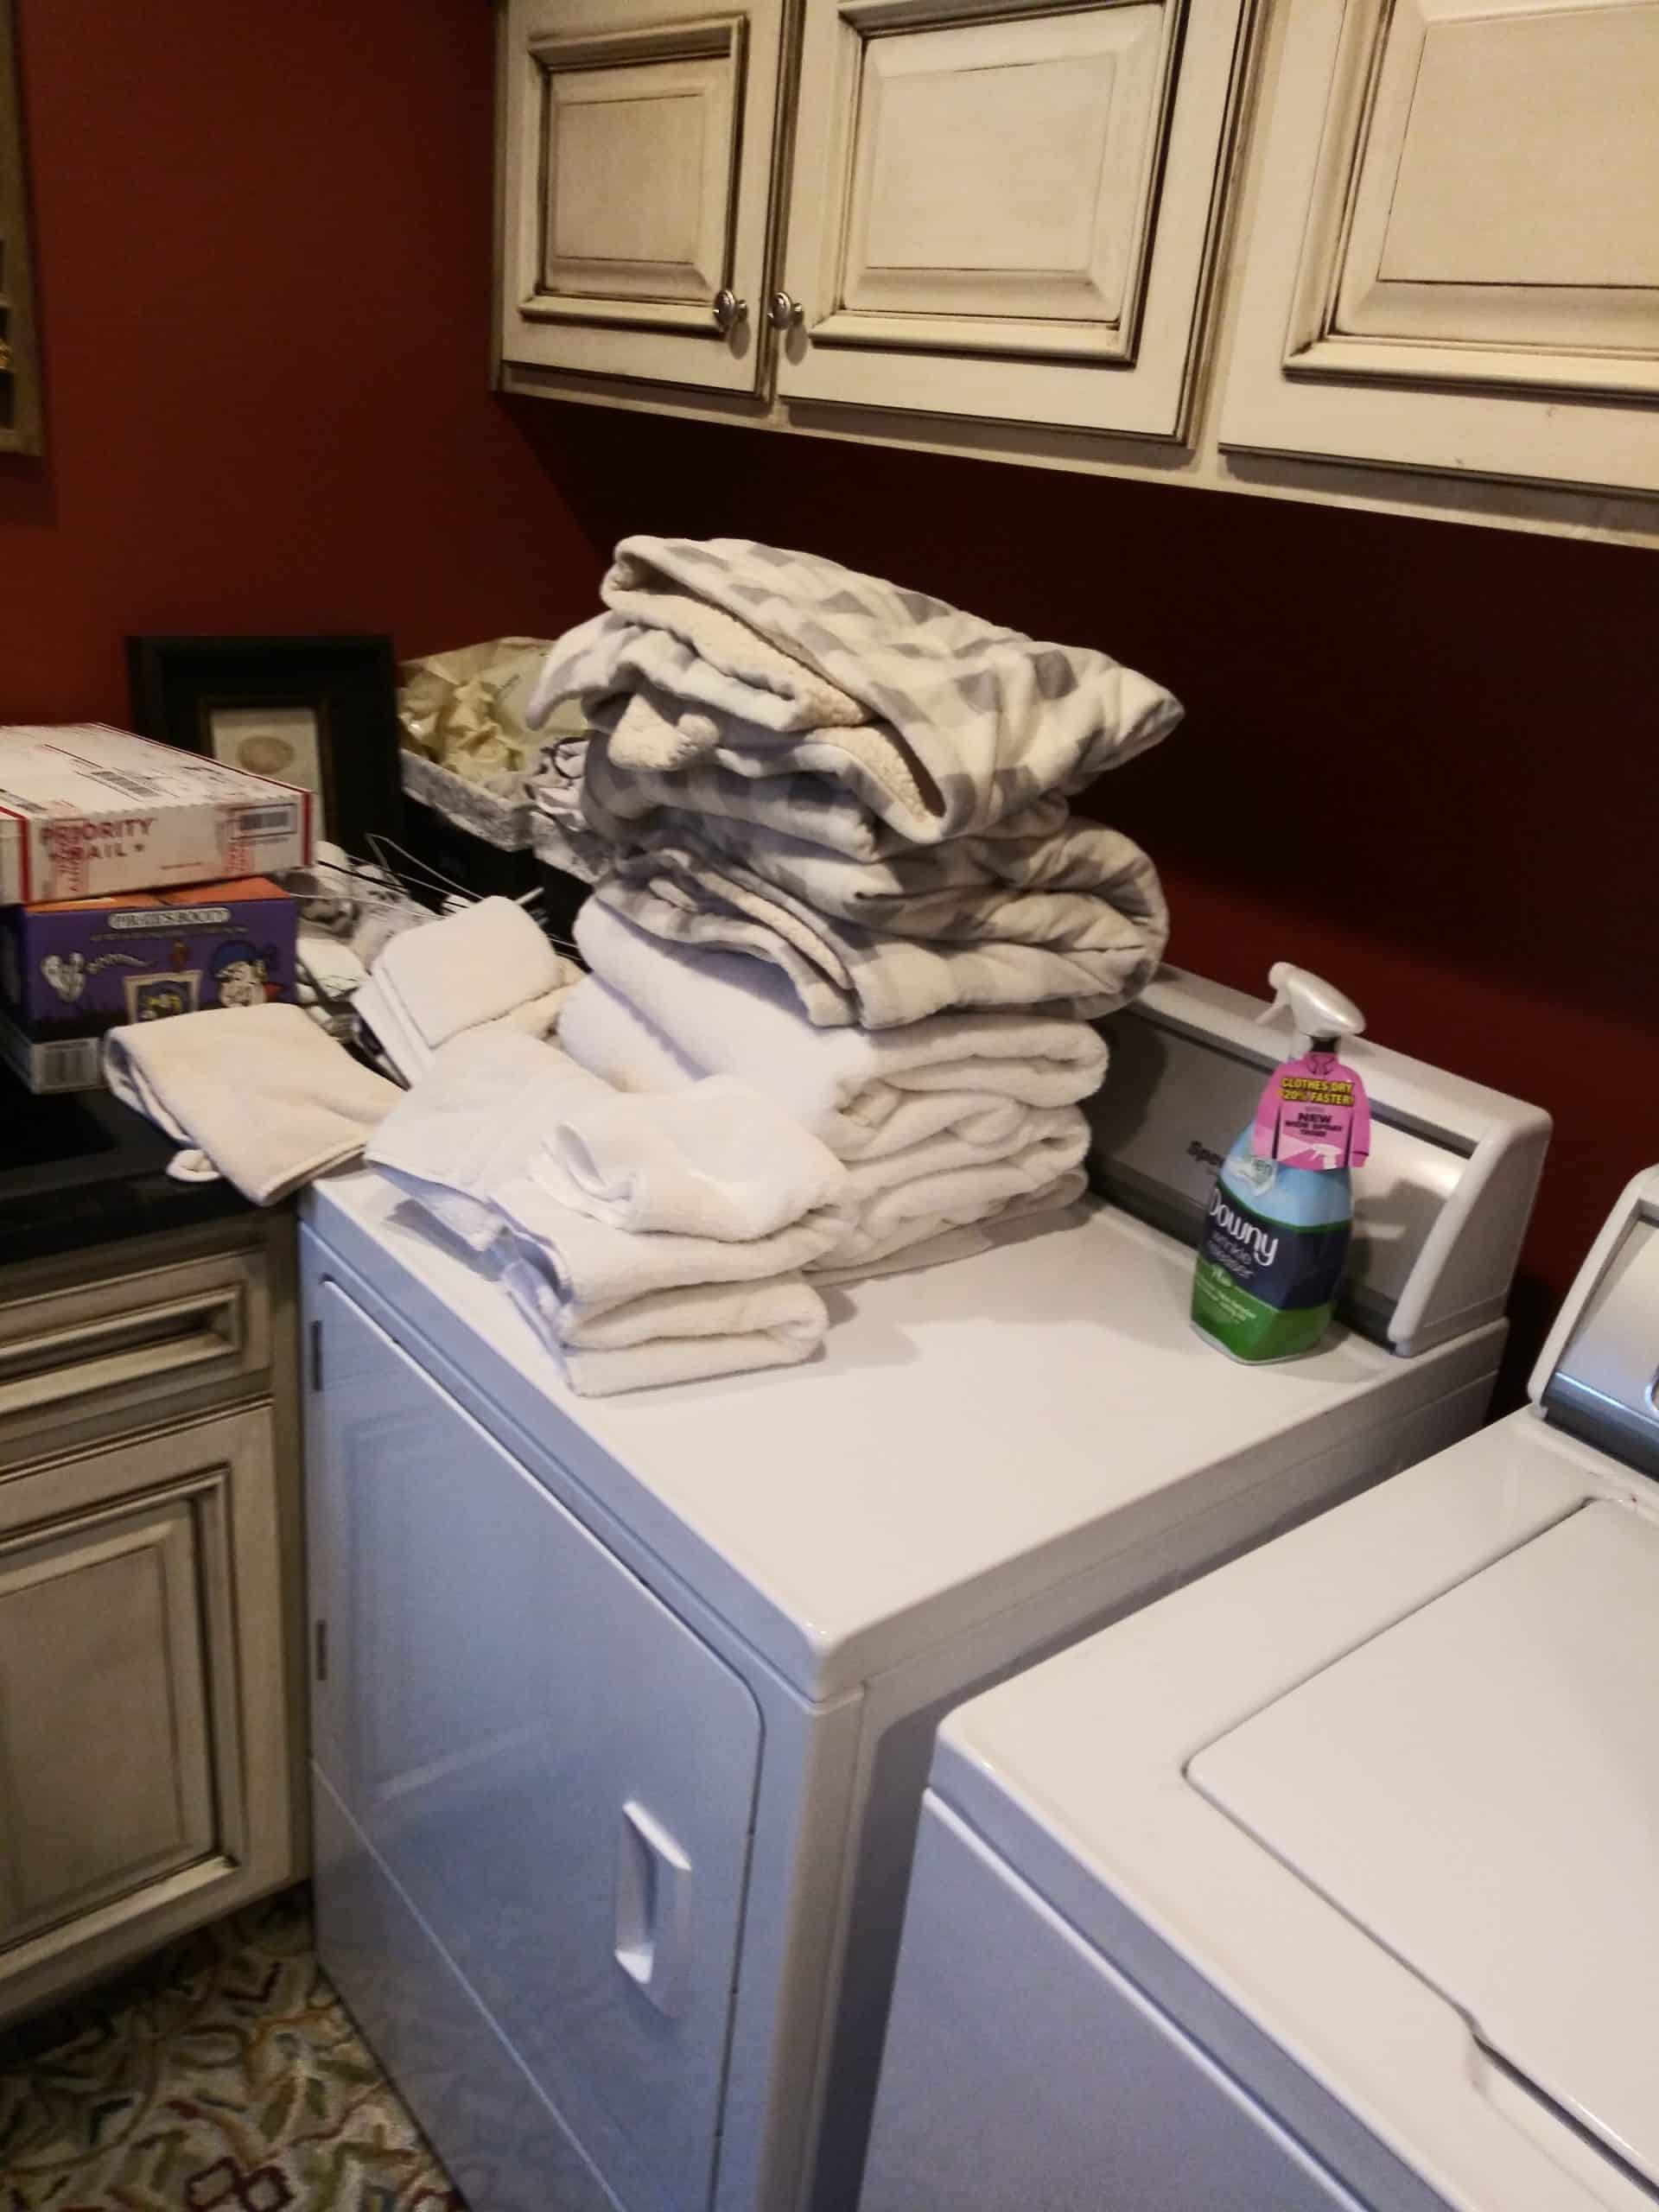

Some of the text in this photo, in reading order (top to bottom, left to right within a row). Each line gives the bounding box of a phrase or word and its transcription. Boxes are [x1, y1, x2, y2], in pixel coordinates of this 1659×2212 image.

[1281, 1077, 1354, 1093] CLOTHES DRY
[1298, 1113, 1332, 1123] NEW
[1210, 1189, 1279, 1267] Downy
